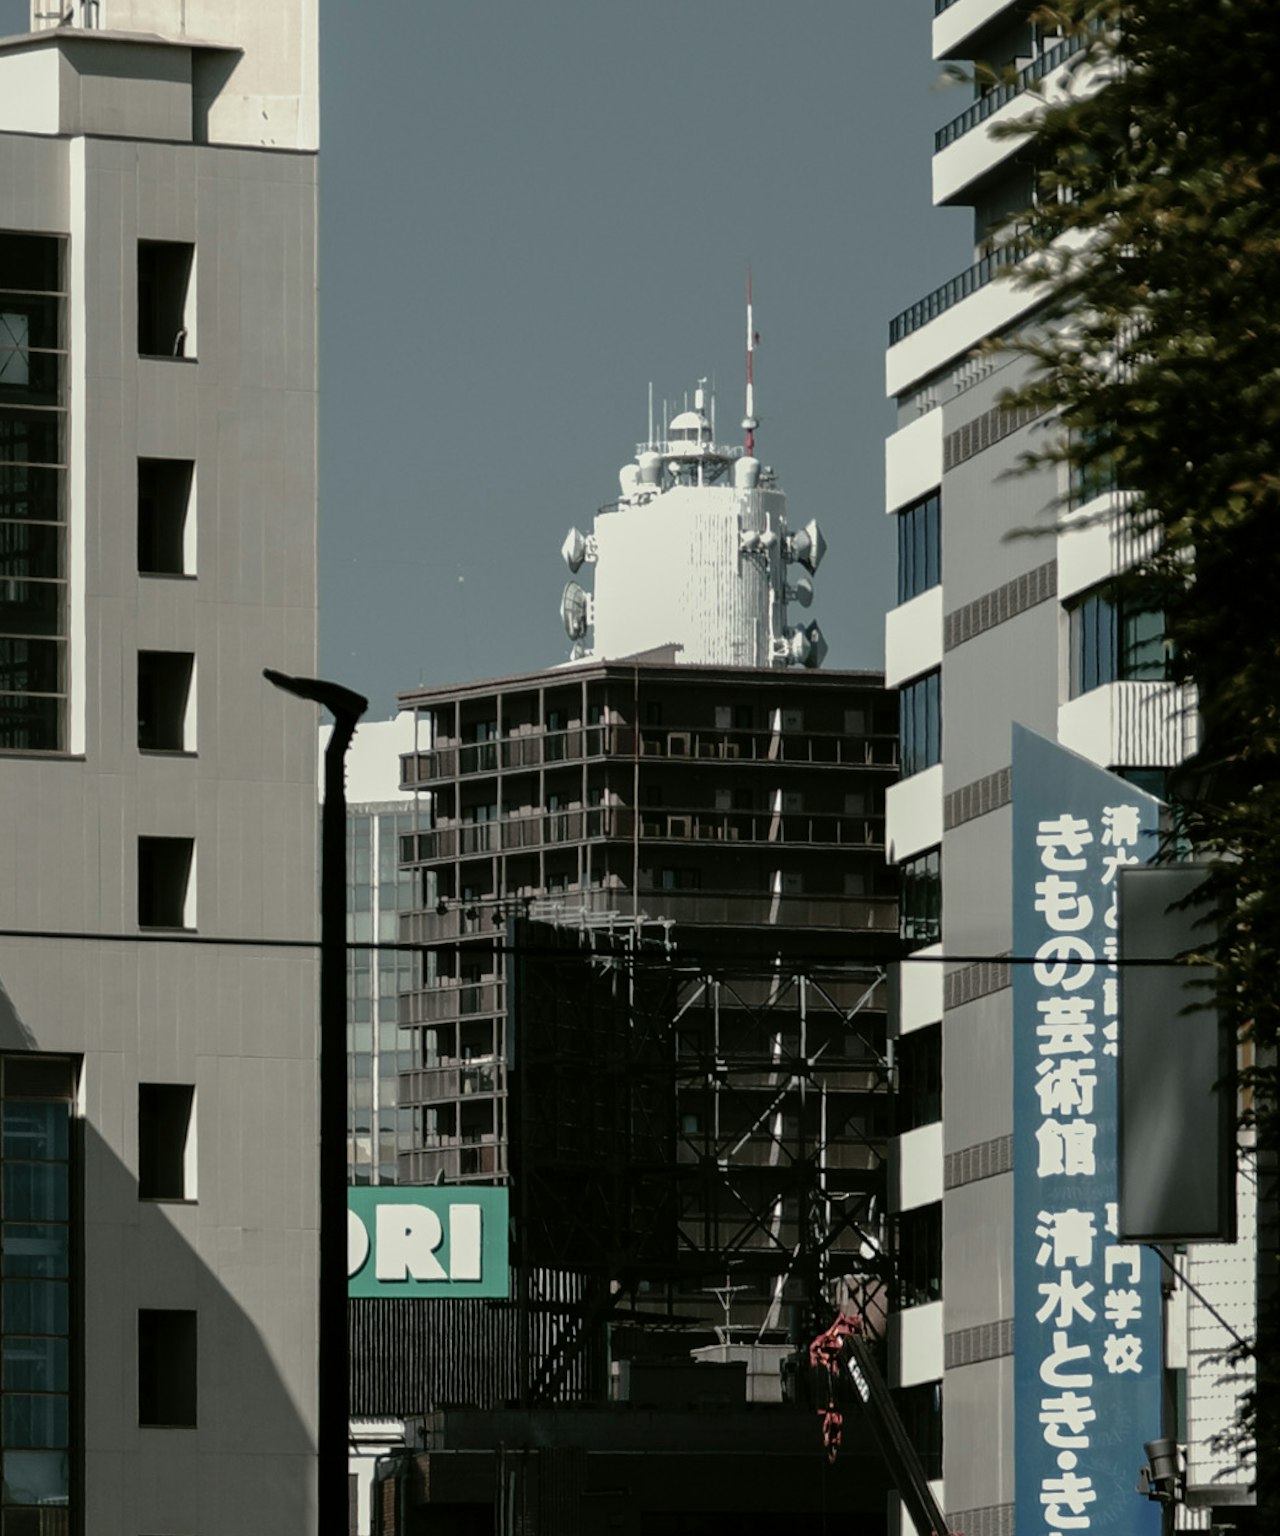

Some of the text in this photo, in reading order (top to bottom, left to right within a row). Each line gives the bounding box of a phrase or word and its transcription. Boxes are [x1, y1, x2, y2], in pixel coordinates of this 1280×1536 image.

[1033, 813, 1097, 1177] きもの芸術館
[348, 1204, 481, 1280] RI
